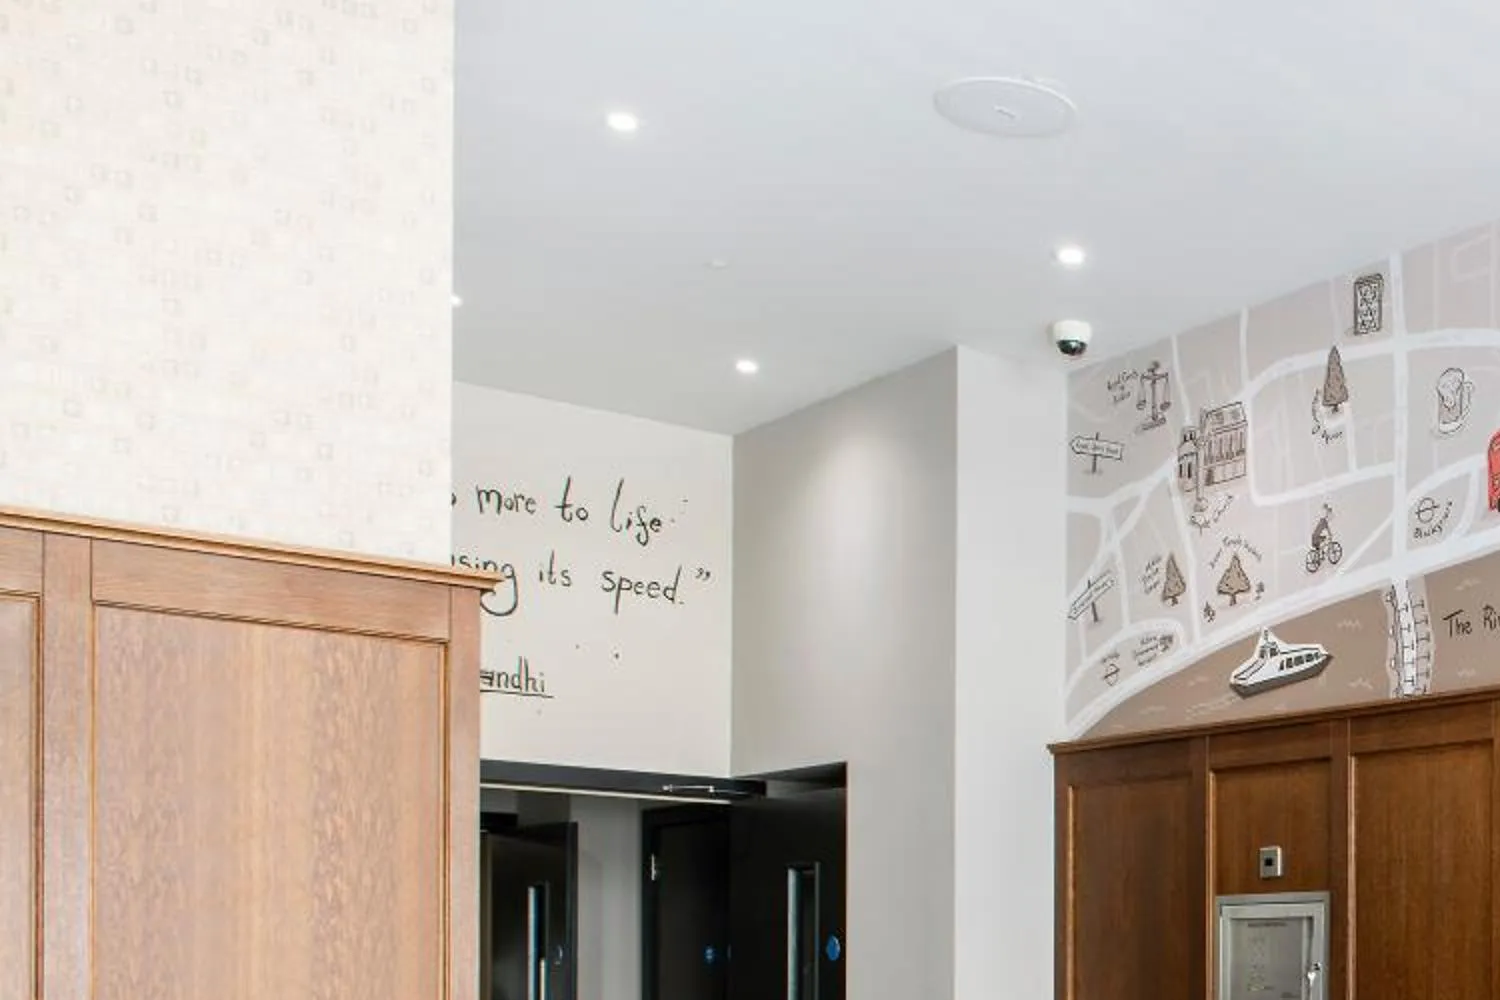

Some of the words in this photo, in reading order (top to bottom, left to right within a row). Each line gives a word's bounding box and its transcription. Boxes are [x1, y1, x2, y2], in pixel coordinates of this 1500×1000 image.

[476, 485, 538, 516] more
[555, 475, 590, 523] to
[539, 550, 573, 587] its
[1442, 609, 1473, 638] The
[480, 655, 547, 693] andhi
